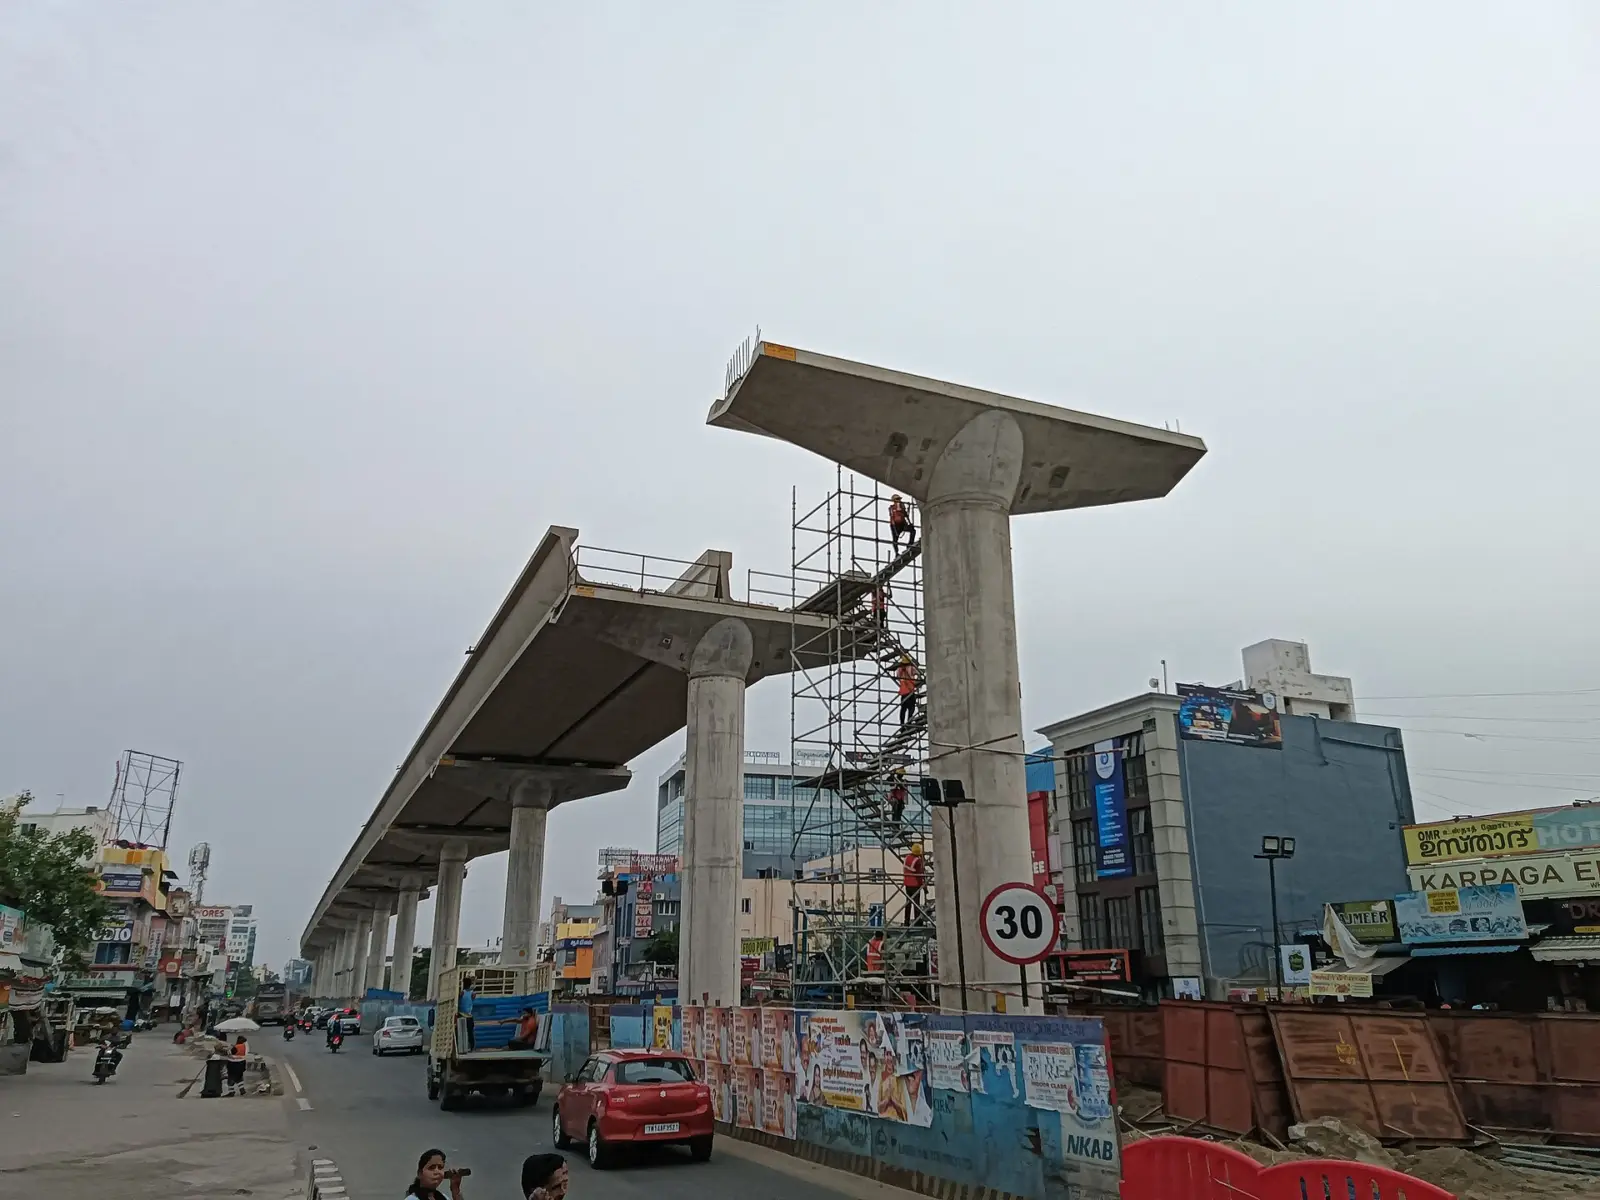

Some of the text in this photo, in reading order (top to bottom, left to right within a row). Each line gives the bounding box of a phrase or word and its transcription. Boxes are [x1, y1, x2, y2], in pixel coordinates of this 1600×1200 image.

[1417, 829, 1441, 841] OMR
[1419, 864, 1565, 891] KARPAGA
[995, 905, 1043, 940] 30
[1067, 1134, 1113, 1161] NKAB
